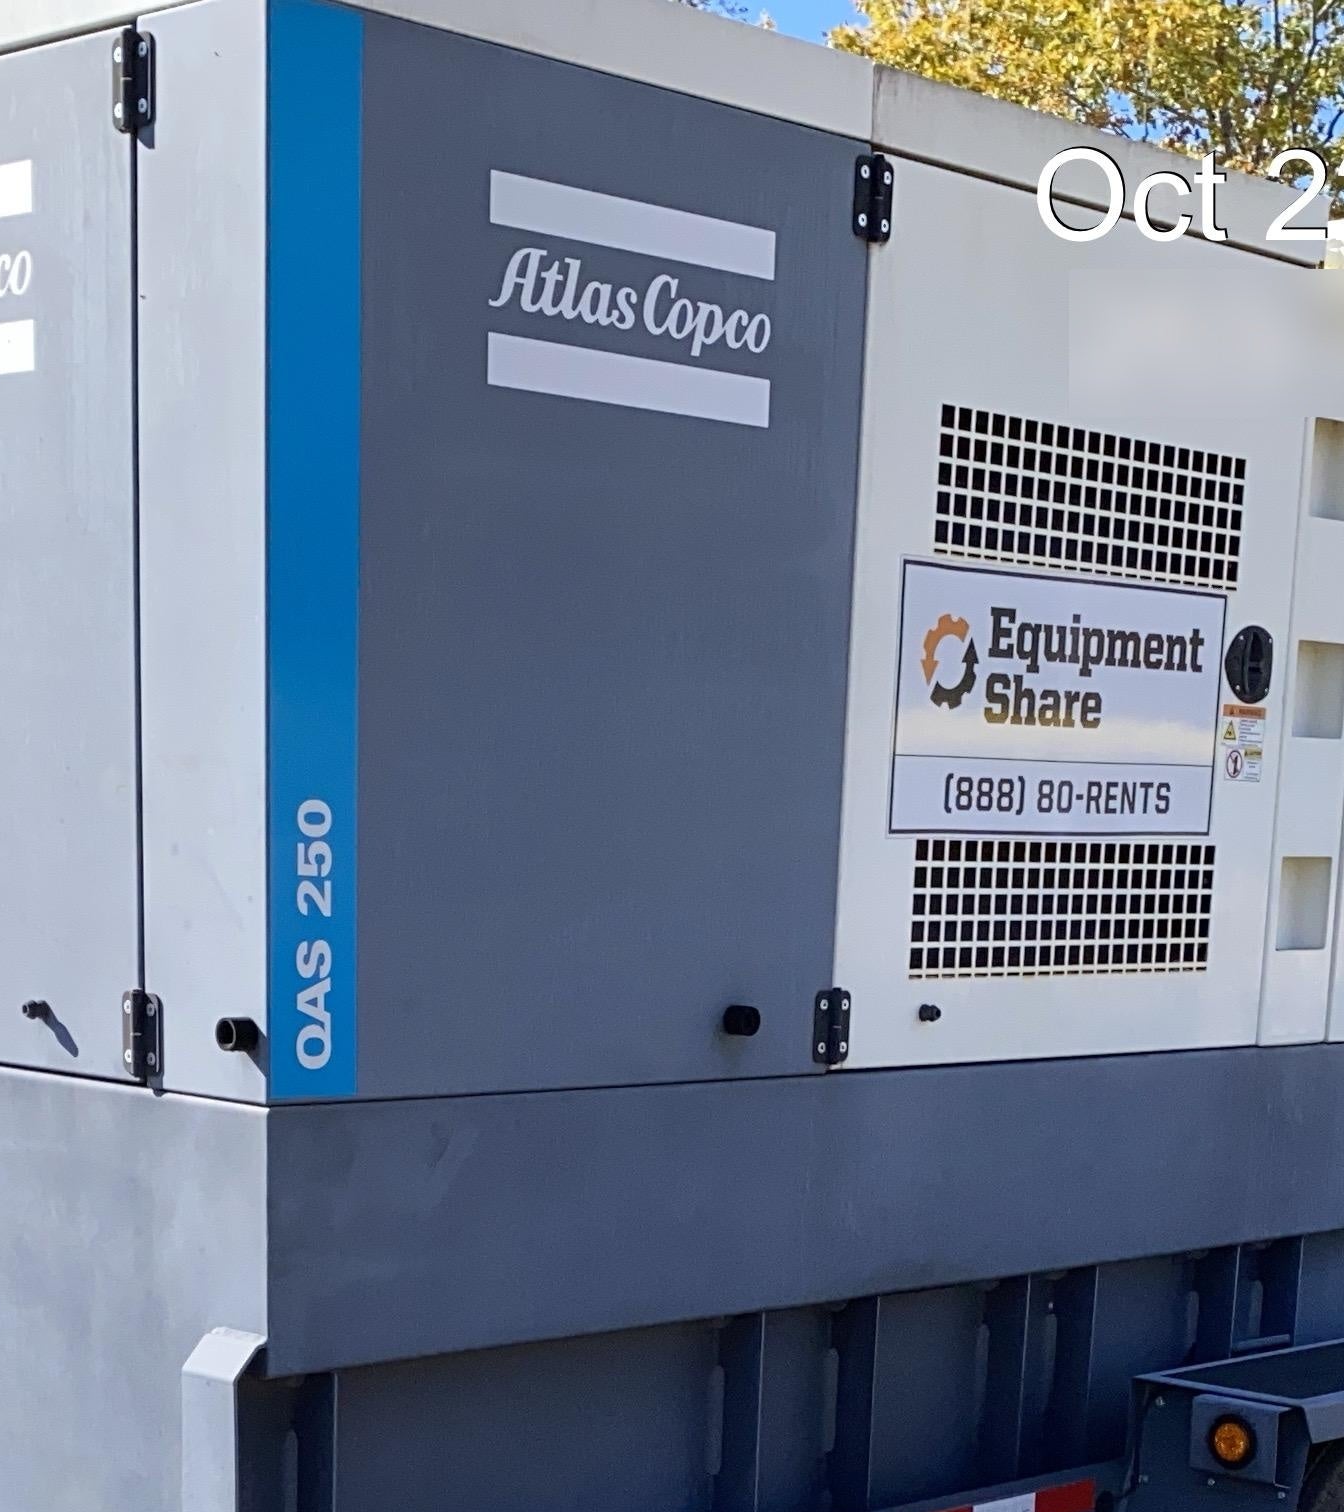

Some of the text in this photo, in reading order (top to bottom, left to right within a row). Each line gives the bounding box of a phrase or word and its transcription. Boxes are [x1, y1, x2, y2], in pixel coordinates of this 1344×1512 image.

[488, 247, 771, 357] Atlas Copco
[987, 606, 1204, 677] Equipment
[983, 673, 1102, 729] Share
[943, 773, 1171, 816] (888) 80-RENTS
[296, 799, 332, 1070] QAS 250
